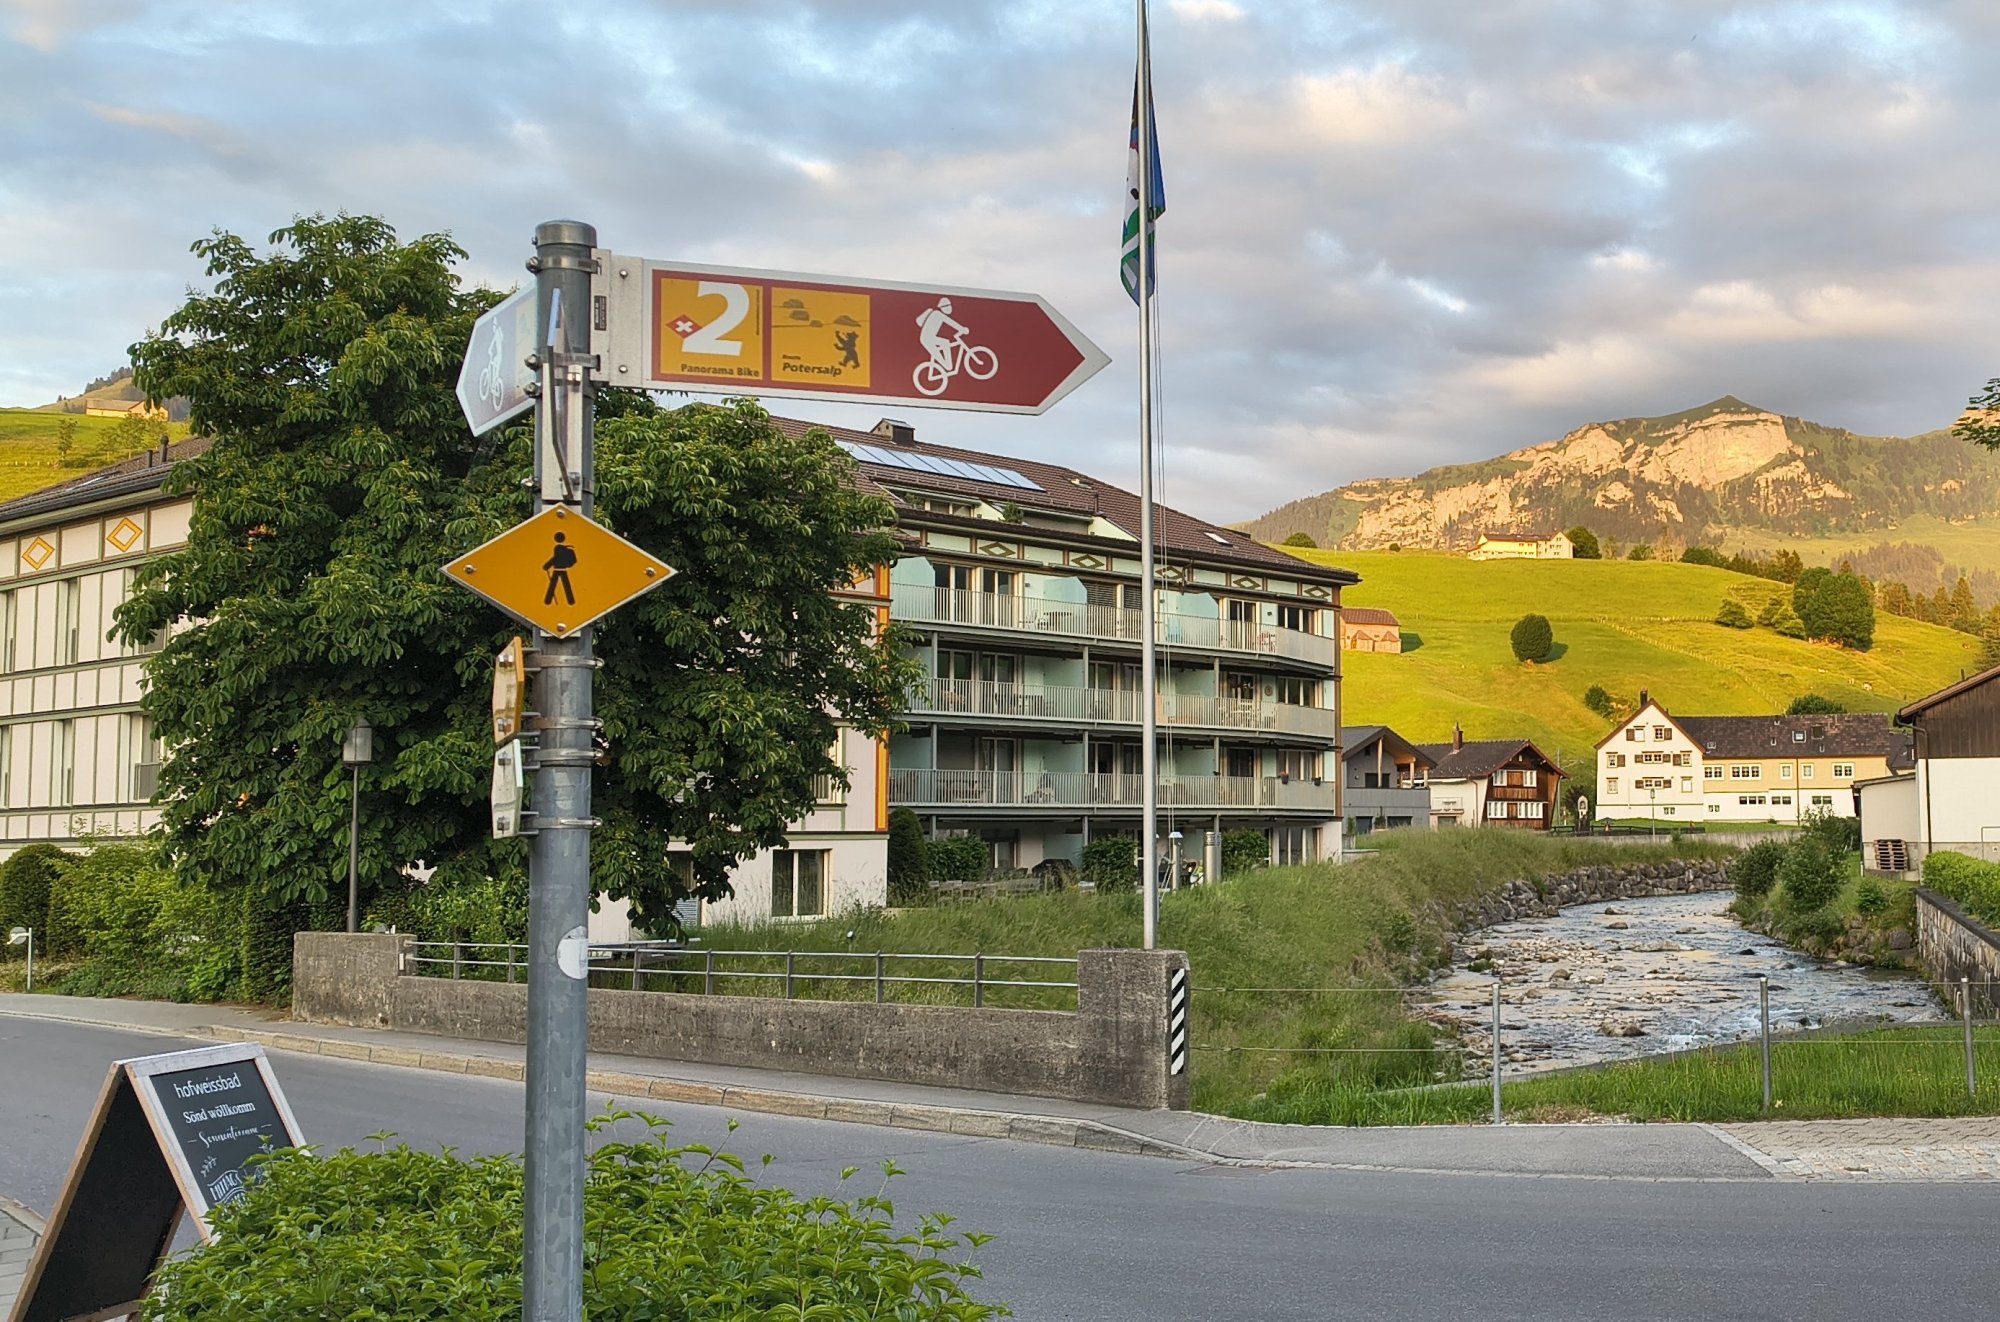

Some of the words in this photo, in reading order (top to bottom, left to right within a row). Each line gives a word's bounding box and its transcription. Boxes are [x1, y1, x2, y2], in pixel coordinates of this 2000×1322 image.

[682, 280, 750, 357] 2
[681, 363, 734, 375] Panorama
[736, 367, 760, 377] Bike
[782, 362, 842, 377] Potersalp
[173, 1072, 242, 1099] hofweissbad
